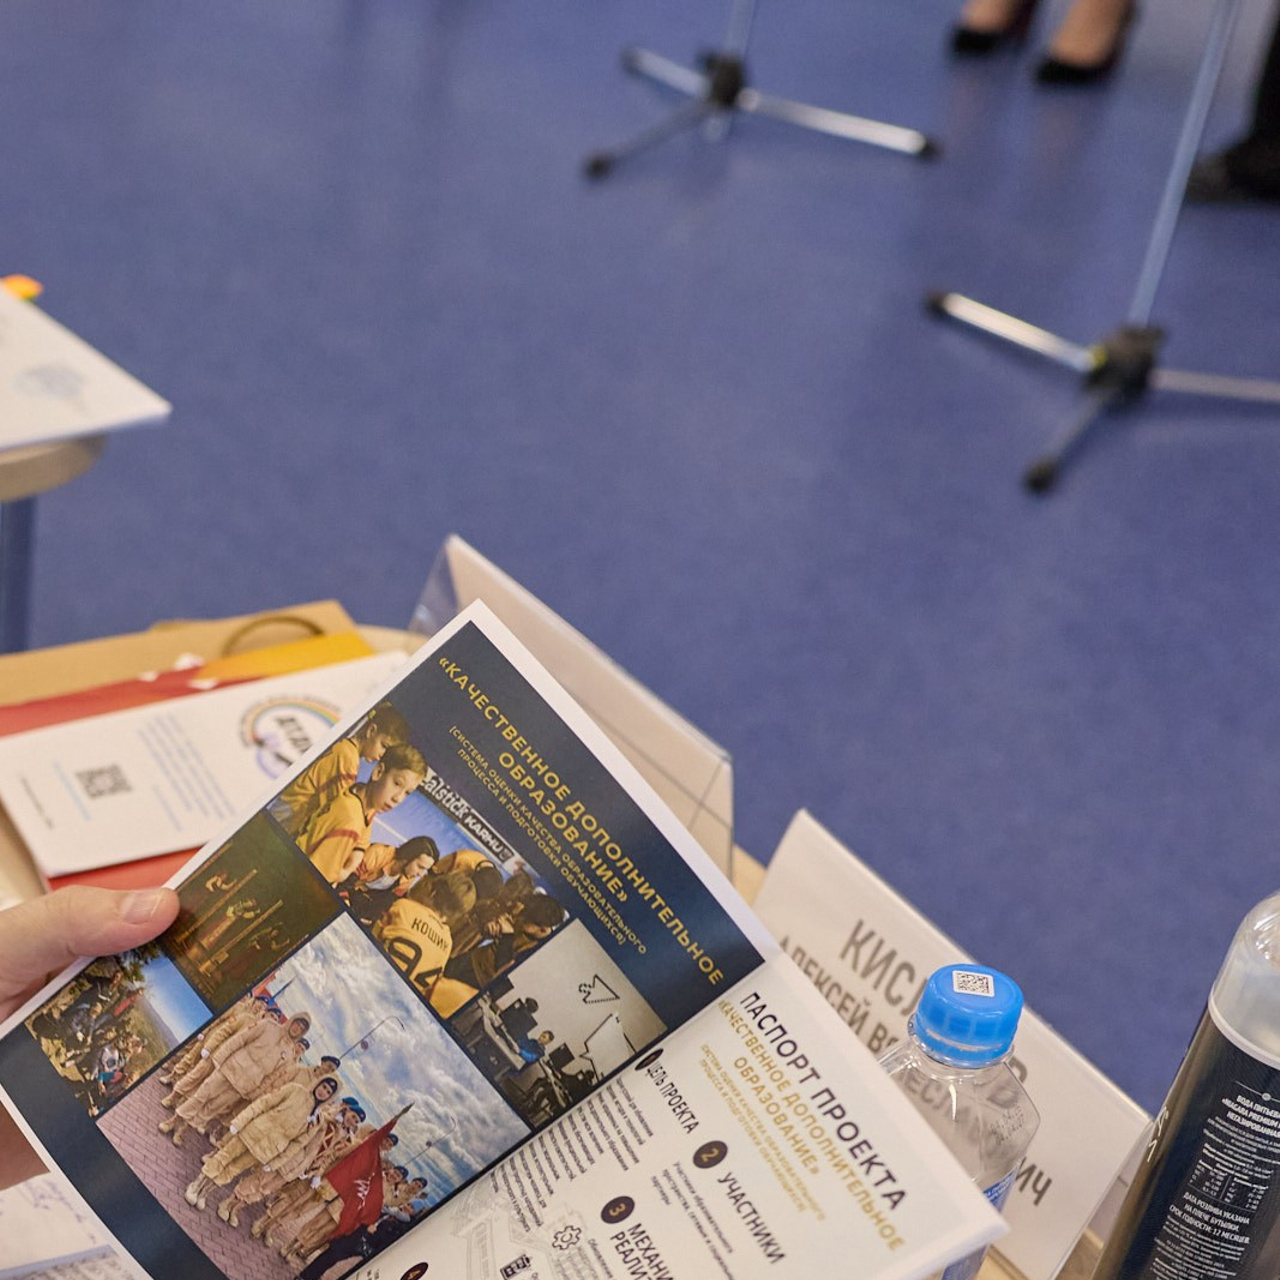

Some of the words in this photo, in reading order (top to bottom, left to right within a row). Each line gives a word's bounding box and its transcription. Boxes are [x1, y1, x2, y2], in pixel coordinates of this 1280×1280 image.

[440, 659, 570, 799] «КАЧЕСТВЕННОЕ
[564, 798, 724, 985] ДОПОЛНИТЕЛЬНОЕ
[458, 749, 499, 796] ПРОЦЕССА
[496, 794, 508, 805] И
[506, 804, 561, 866] ПОДГОТОВКИ
[463, 815, 504, 854] KARHU
[500, 753, 626, 900] ОБРАЗОВАНИЕ»
[489, 769, 521, 805] ОЦЕНКИ
[520, 805, 561, 853] КАЧЕСТВА
[561, 857, 645, 953] ОБРАЗОВАТЕЛЬНОГО
[645, 1063, 668, 1087] ЦЕЛЬ
[660, 1082, 698, 1133] ПРОЕКТА
[734, 1057, 818, 1173] ОБРАЗОВАНИЕ»
[741, 993, 819, 1082] ПАСПОРТ
[812, 1088, 904, 1208] ПРОЕКТА
[701, 1148, 719, 1162] 2
[783, 1094, 902, 1249] ДОПОЛНИТЕЛЬНОЕ
[608, 1202, 626, 1218] 3
[673, 1162, 696, 1194] Участники
[694, 1195, 732, 1253] образовательного
[718, 1173, 784, 1262] УЧАСТНИКИ
[1183, 1191, 1197, 1204] ДАТА
[1222, 1210, 1250, 1224] УКАЗАНА
[406, 1269, 421, 1280] 4
